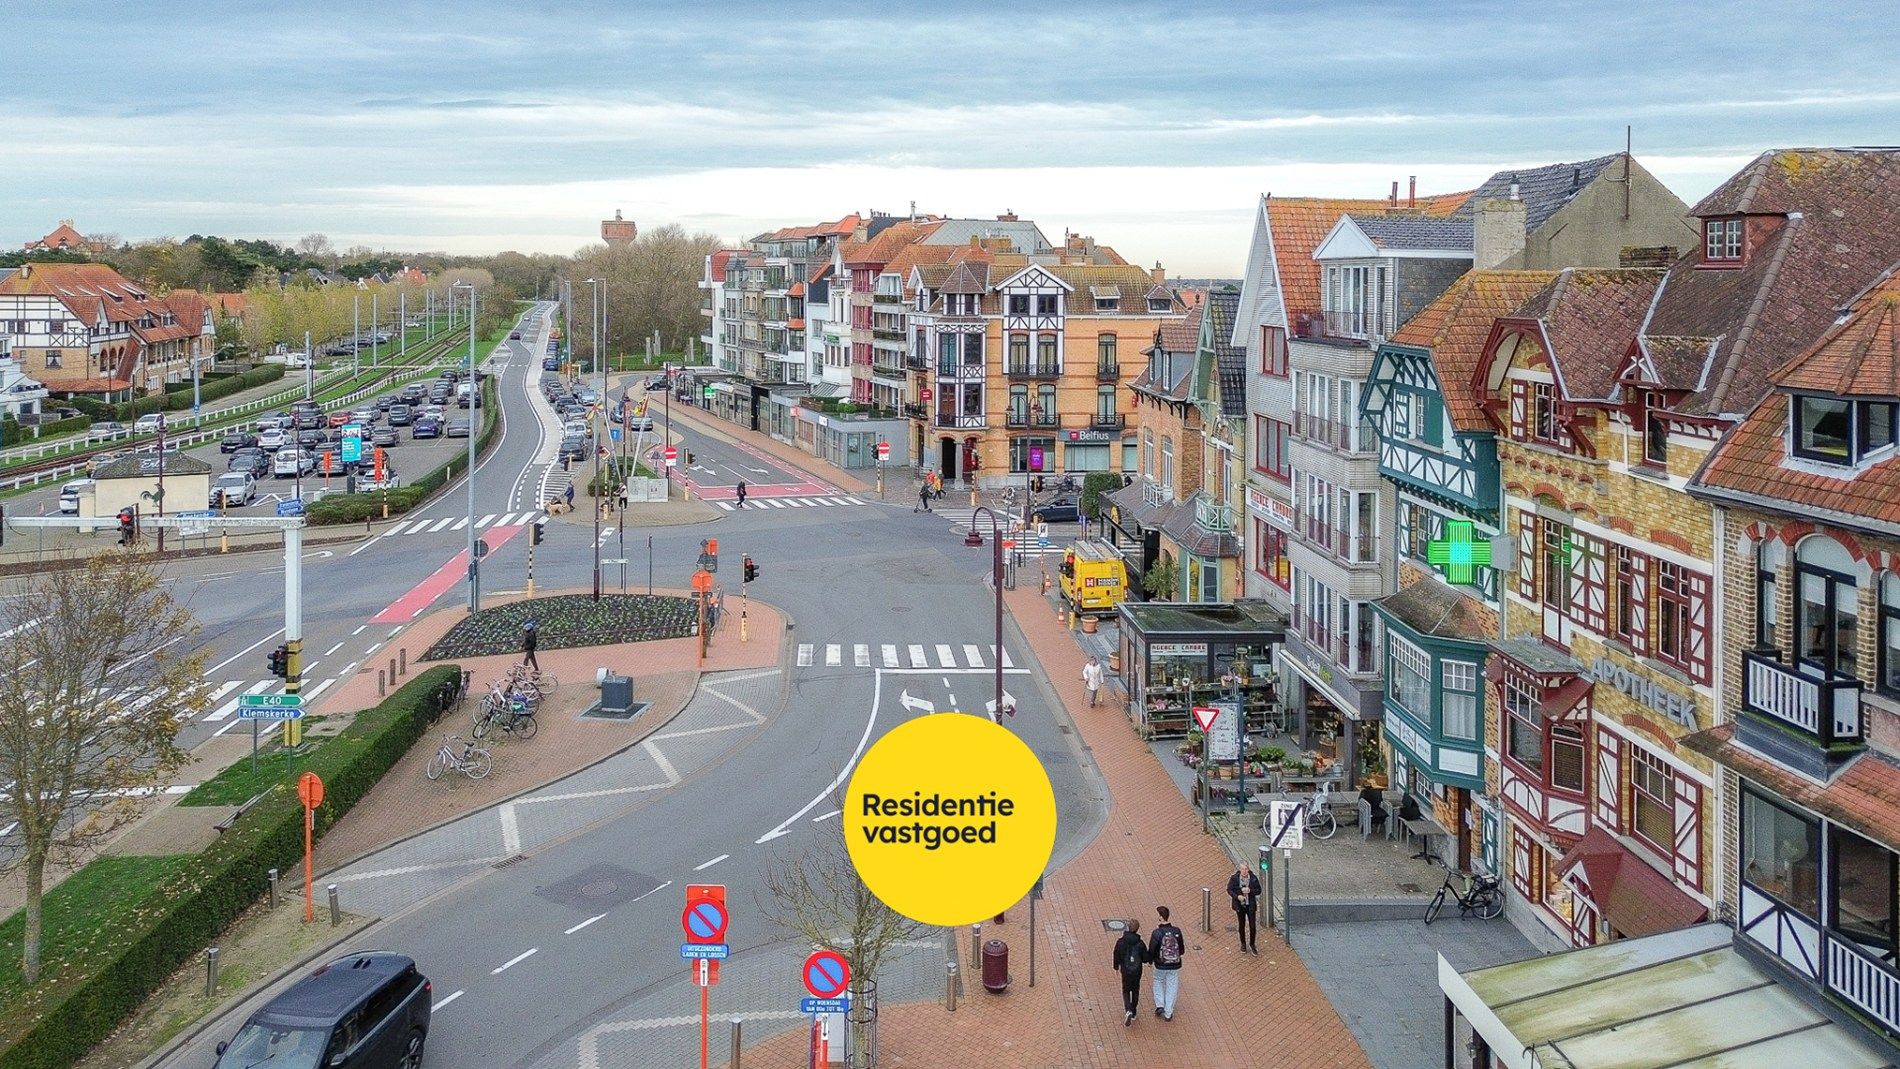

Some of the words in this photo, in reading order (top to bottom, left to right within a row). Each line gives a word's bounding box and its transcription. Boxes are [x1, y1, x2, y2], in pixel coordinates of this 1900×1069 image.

[1080, 431, 1109, 440] Belfius
[1590, 656, 1699, 732] APOTHEEK
[262, 696, 282, 705] E40
[242, 709, 294, 718] Klemskerke
